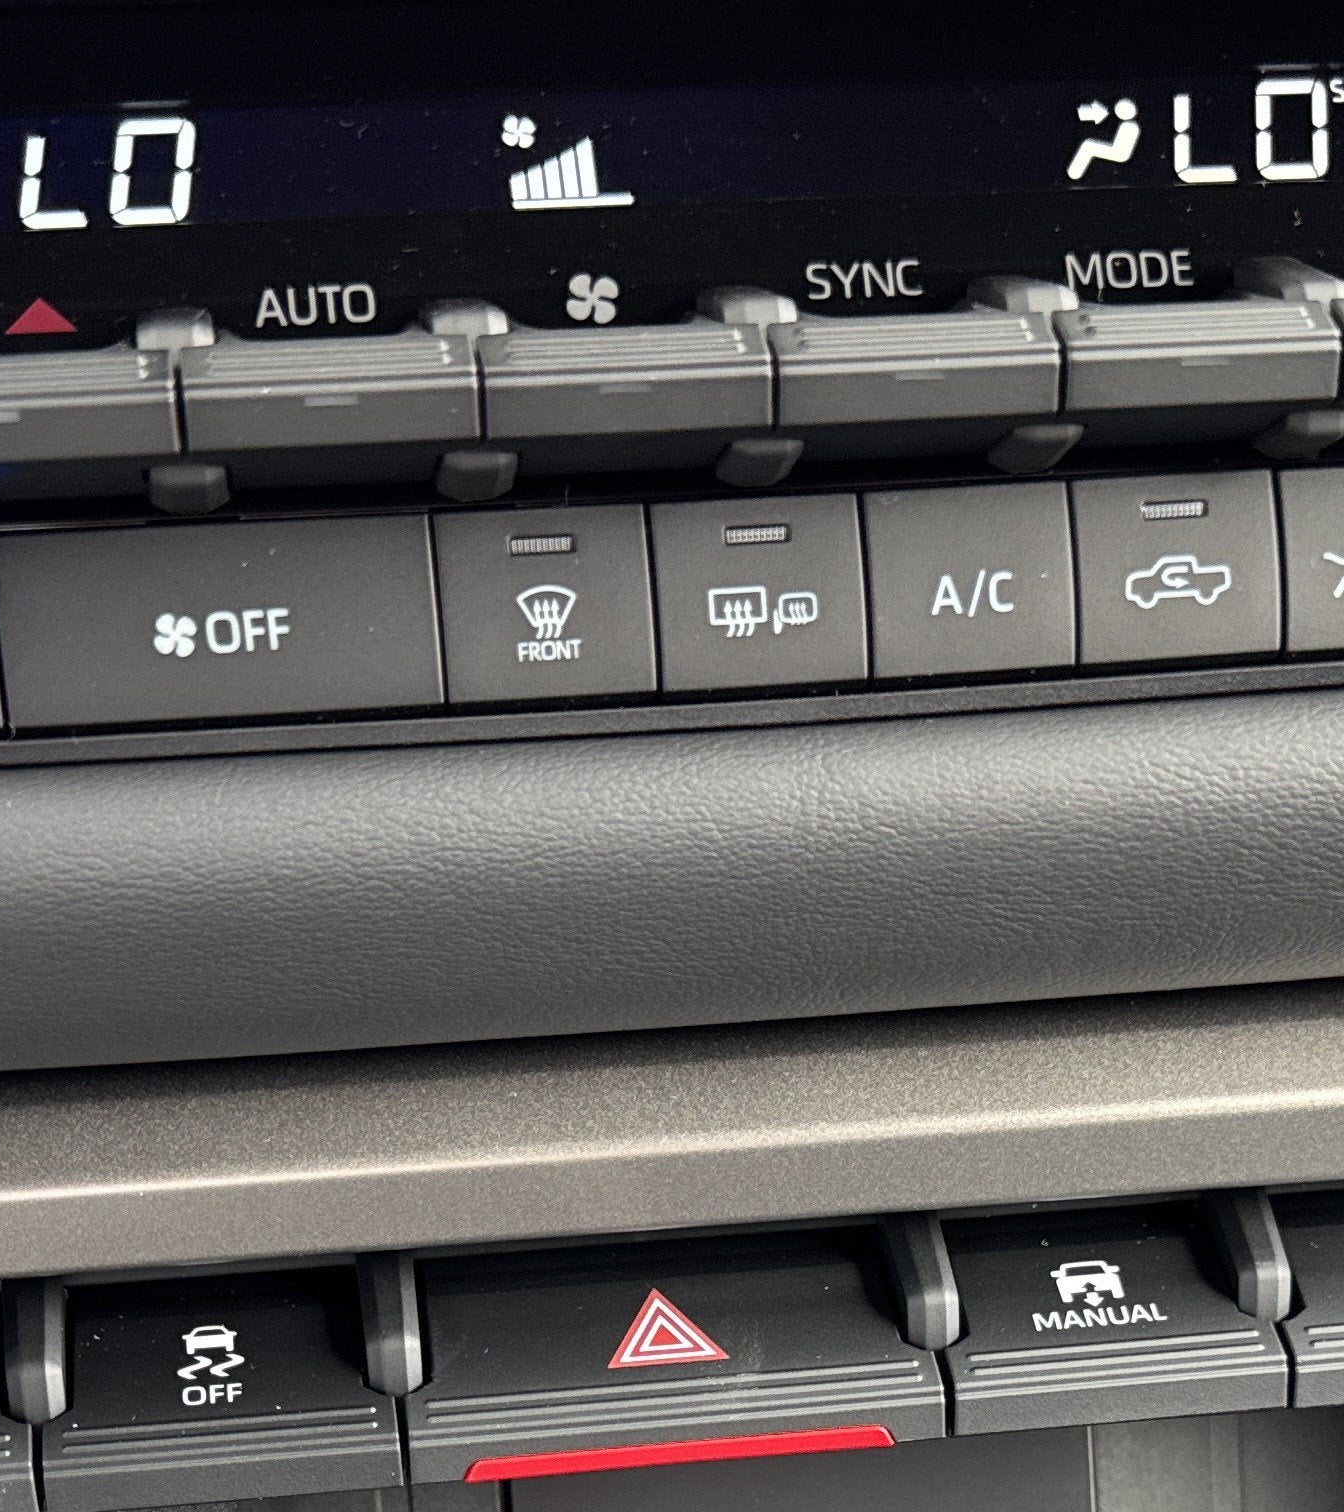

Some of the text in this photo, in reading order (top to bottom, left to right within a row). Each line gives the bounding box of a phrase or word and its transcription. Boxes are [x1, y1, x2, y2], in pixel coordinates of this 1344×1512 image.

[805, 259, 923, 300] SYNC
[1063, 250, 1194, 291] MODE
[256, 283, 376, 329] AUTO
[931, 568, 1015, 618] A/C
[205, 607, 290, 654] OFF
[517, 636, 582, 663] FRONT
[1031, 1301, 1168, 1332] MANUAL
[181, 1382, 243, 1406] OFF
